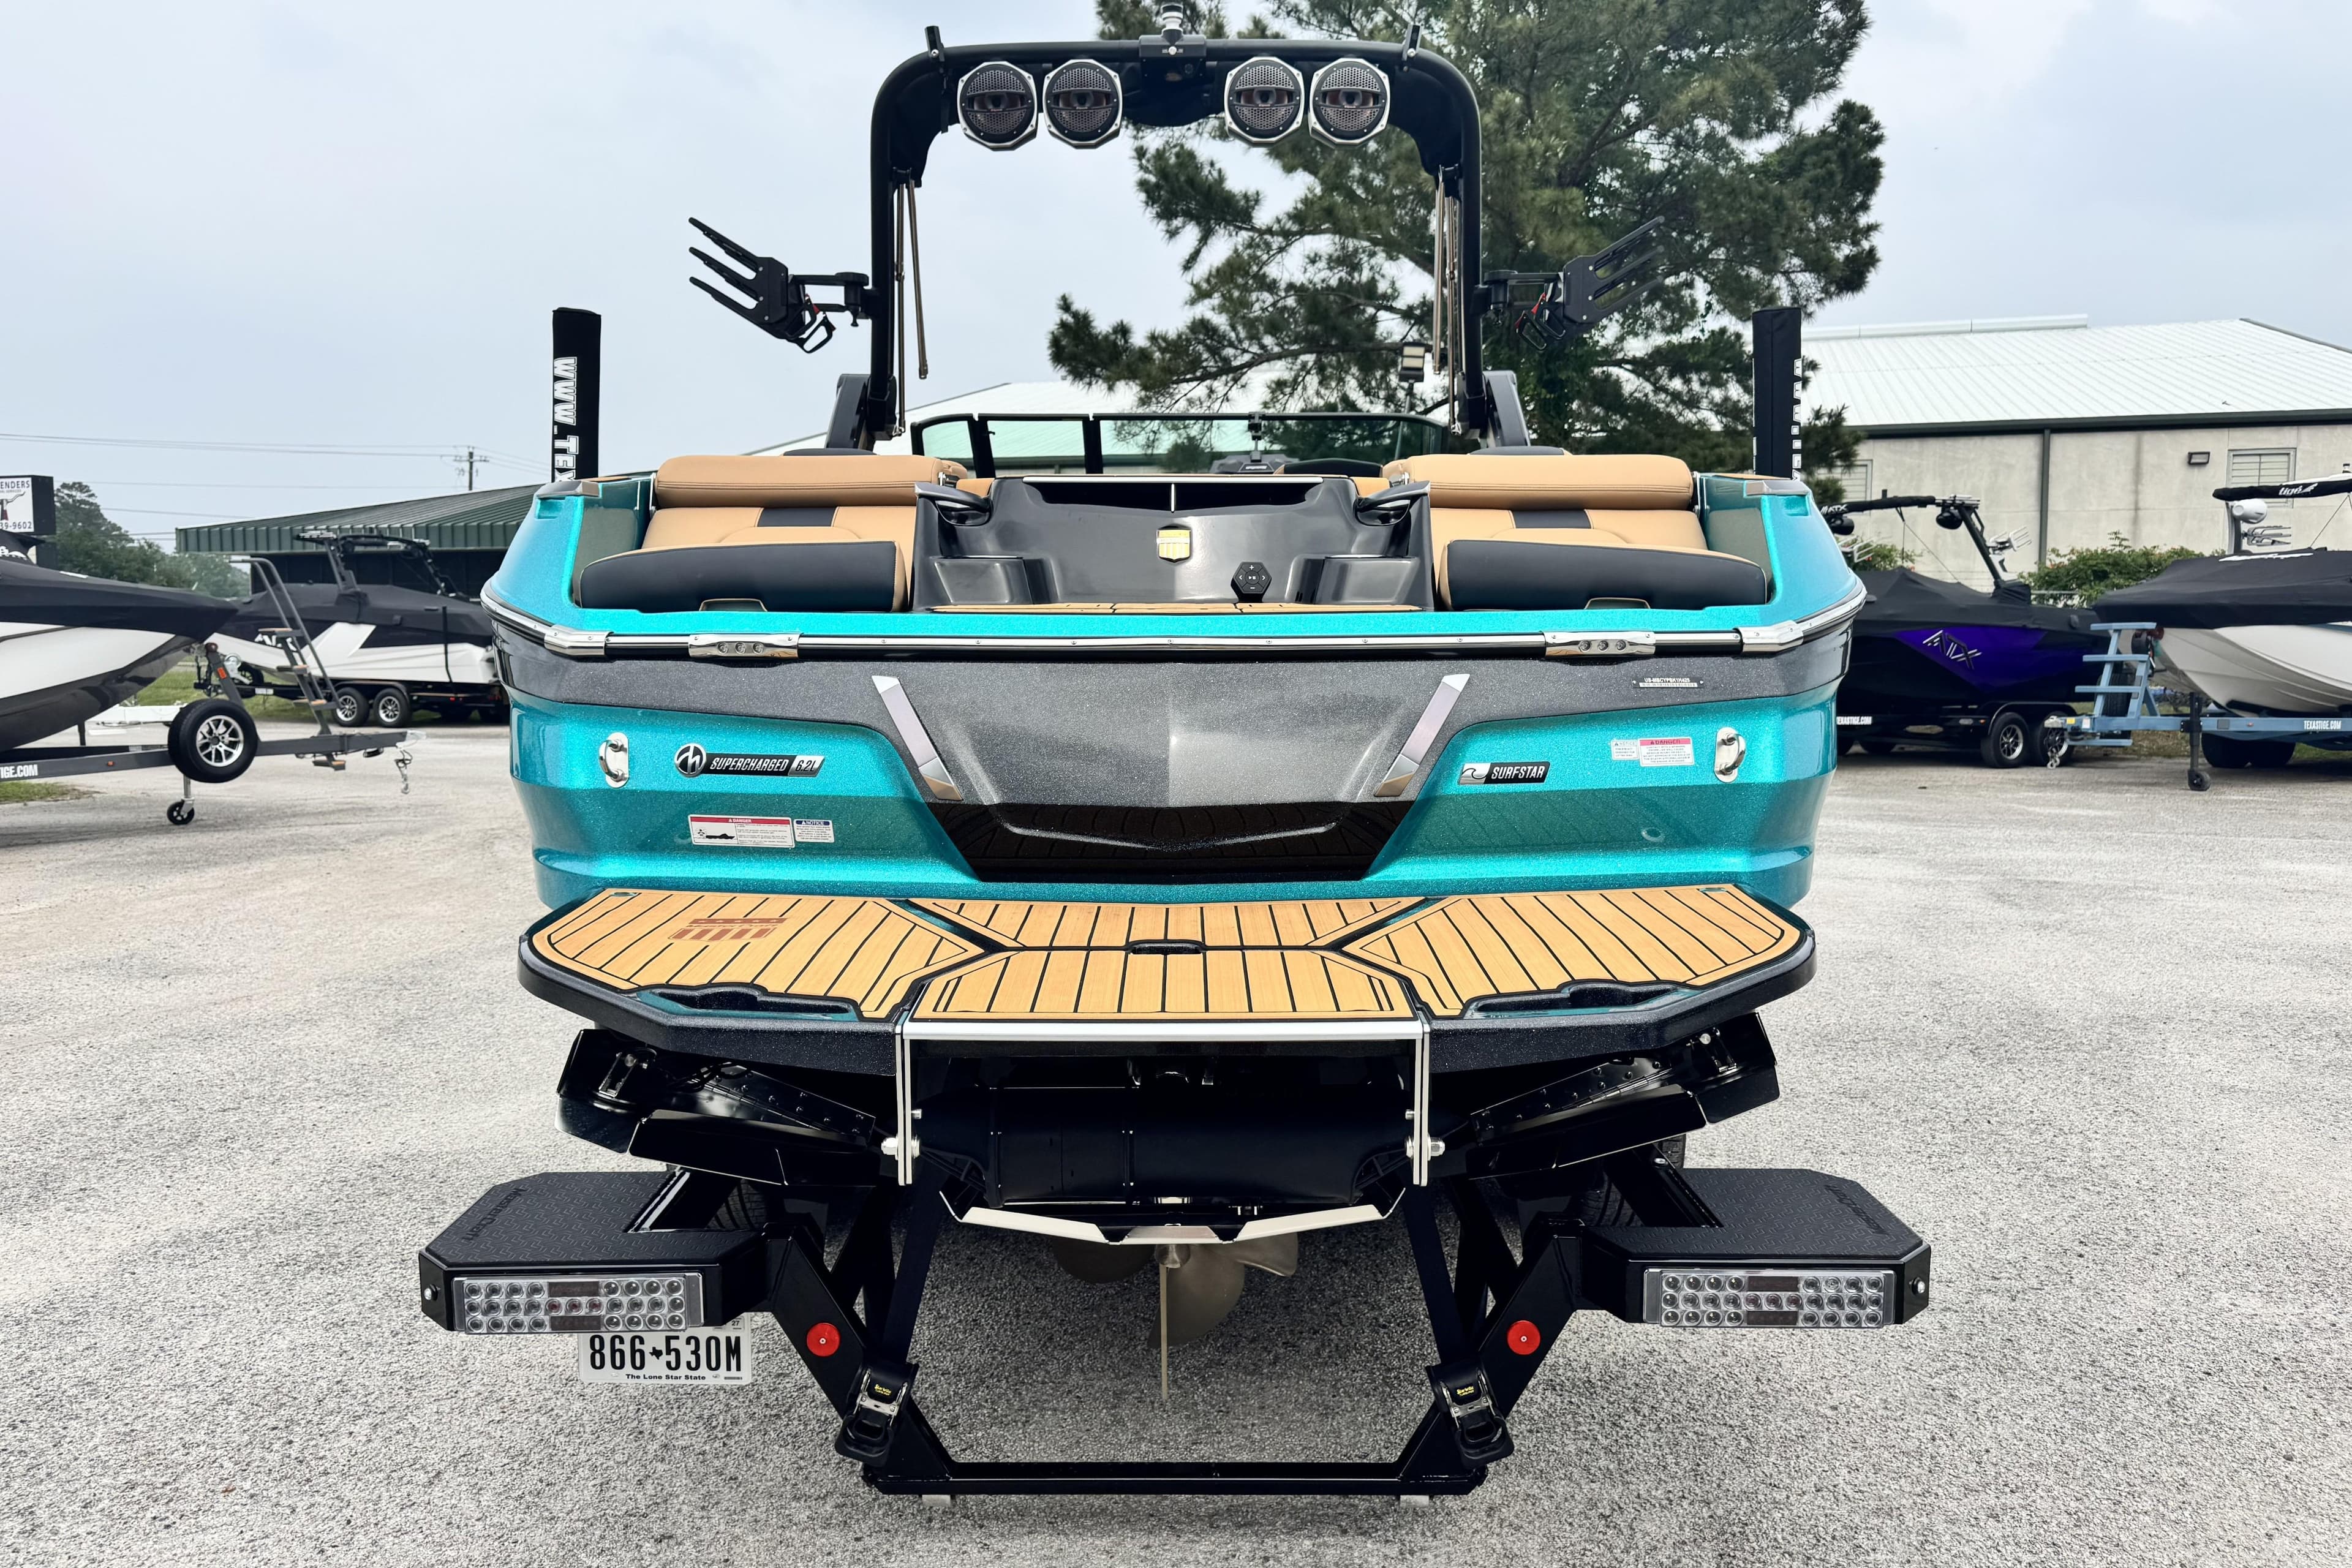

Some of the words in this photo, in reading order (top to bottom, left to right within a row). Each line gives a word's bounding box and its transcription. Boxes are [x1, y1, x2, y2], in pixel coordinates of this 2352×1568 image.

[0, 480, 30, 489] ENDERS
[2304, 720, 2342, 730] TEXASTIGE.COM
[0, 764, 38, 778] IGE.COM
[710, 757, 789, 771] SUPERCHARGED
[795, 760, 816, 772] 6.2L
[1491, 766, 1545, 780] SURFSTAR
[589, 1334, 646, 1371] 866
[665, 1335, 742, 1372] 530M
